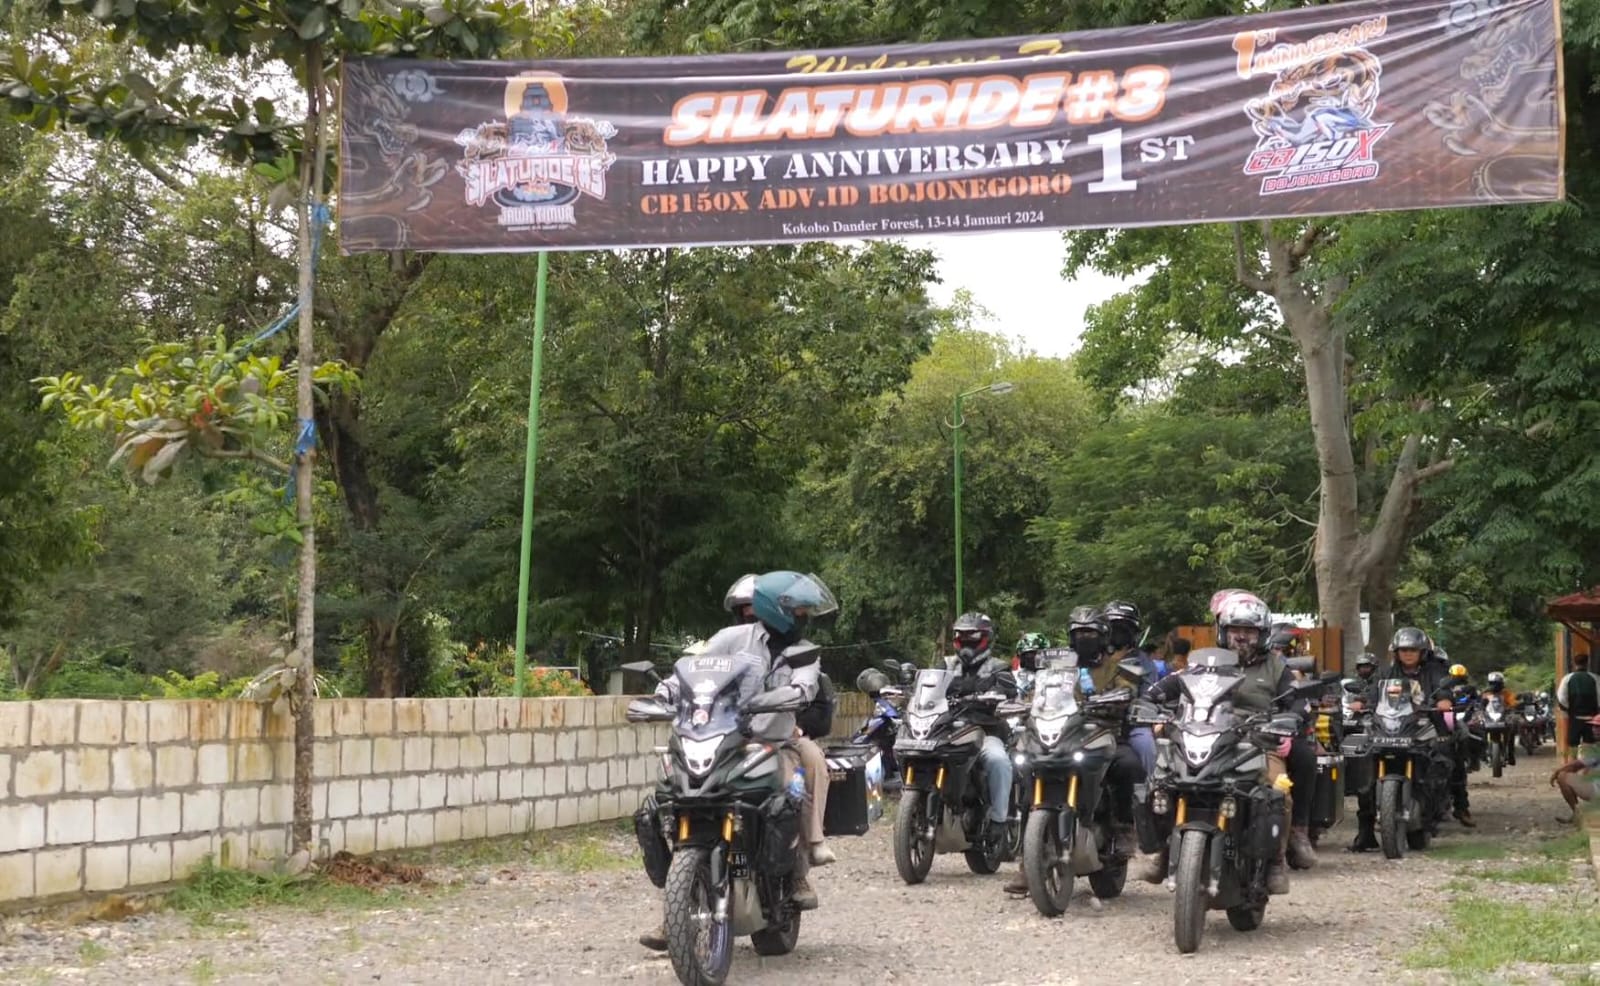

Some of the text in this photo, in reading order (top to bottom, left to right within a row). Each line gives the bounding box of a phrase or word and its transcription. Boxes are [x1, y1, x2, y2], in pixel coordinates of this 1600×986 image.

[641, 155, 772, 186] HAPPY
[783, 139, 1071, 180] ANNIVERSARY
[1264, 164, 1376, 192] BOJONEGORO
[640, 173, 1072, 215] CB150X ADV.ID BOJONEGORO
[782, 209, 1045, 235] Kokobo Dander Forest, 13-14 Januari 2024
